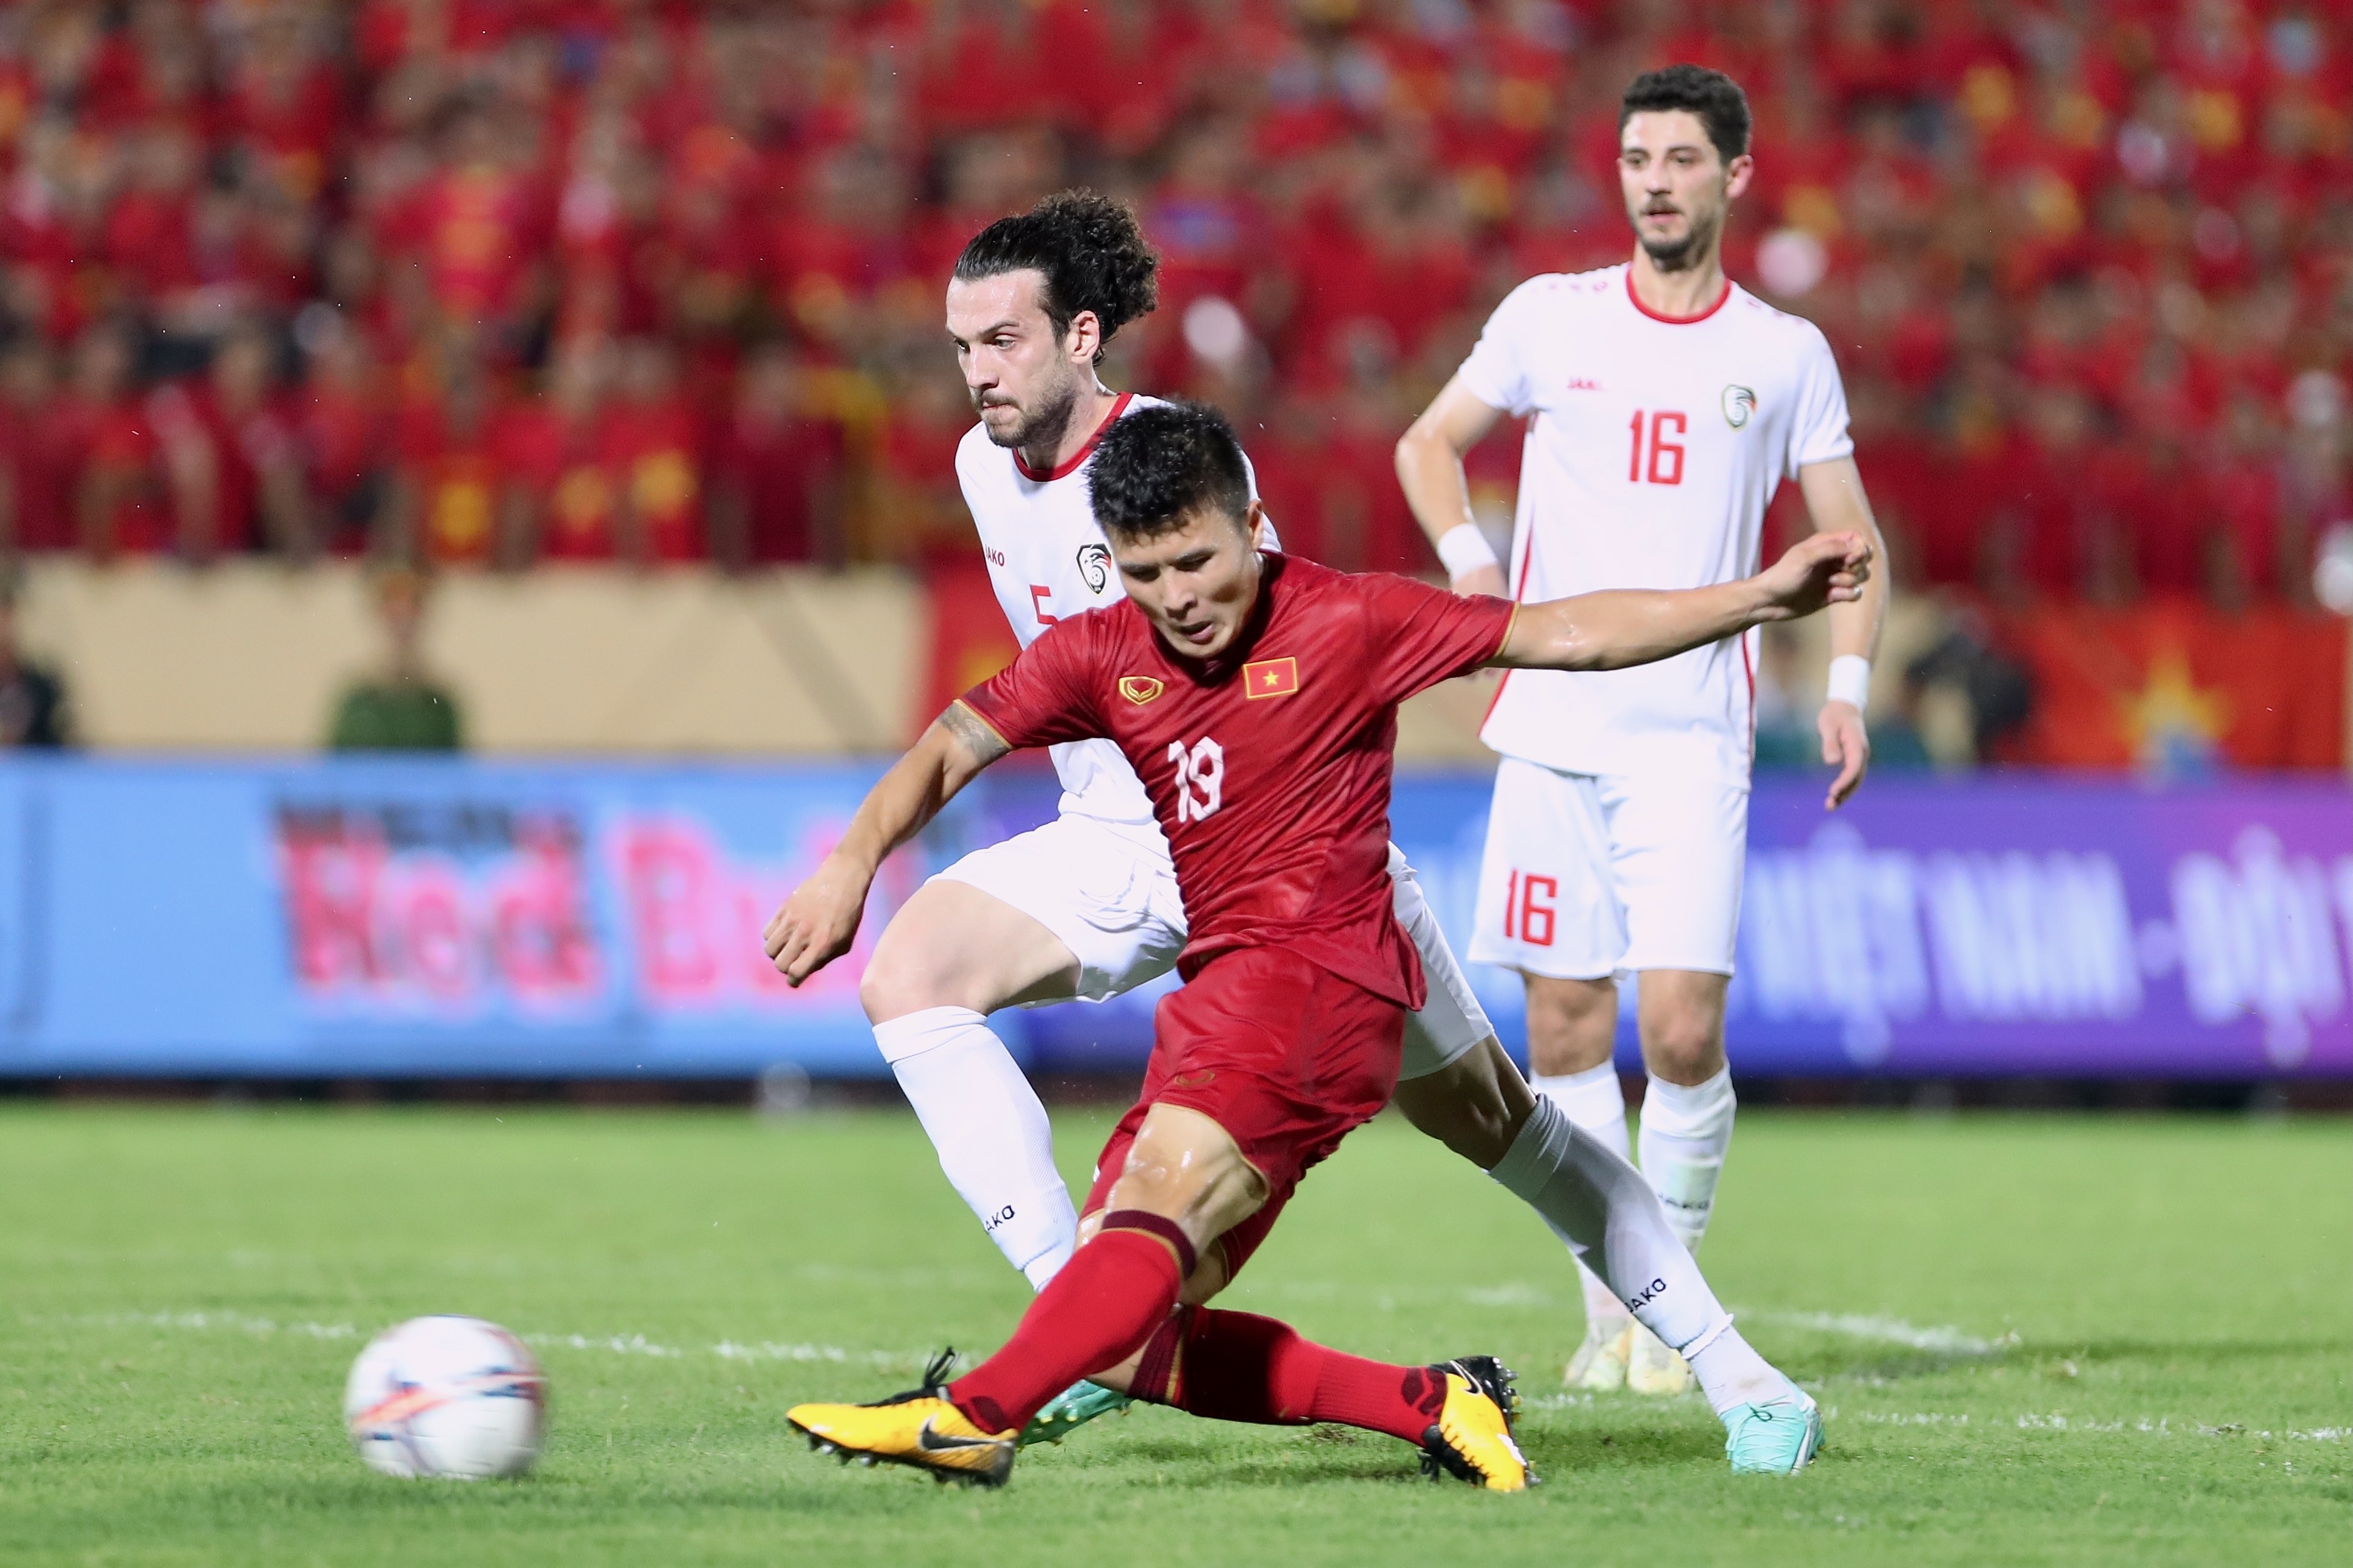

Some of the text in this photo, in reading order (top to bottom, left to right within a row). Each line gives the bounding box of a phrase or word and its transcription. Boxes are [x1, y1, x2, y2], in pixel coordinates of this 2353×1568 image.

[1629, 410, 1687, 485] 16
[1029, 584, 1059, 625] 5
[1168, 736, 1224, 823] 19
[1505, 868, 1557, 946] 16
[983, 1205, 1015, 1233] AKO
